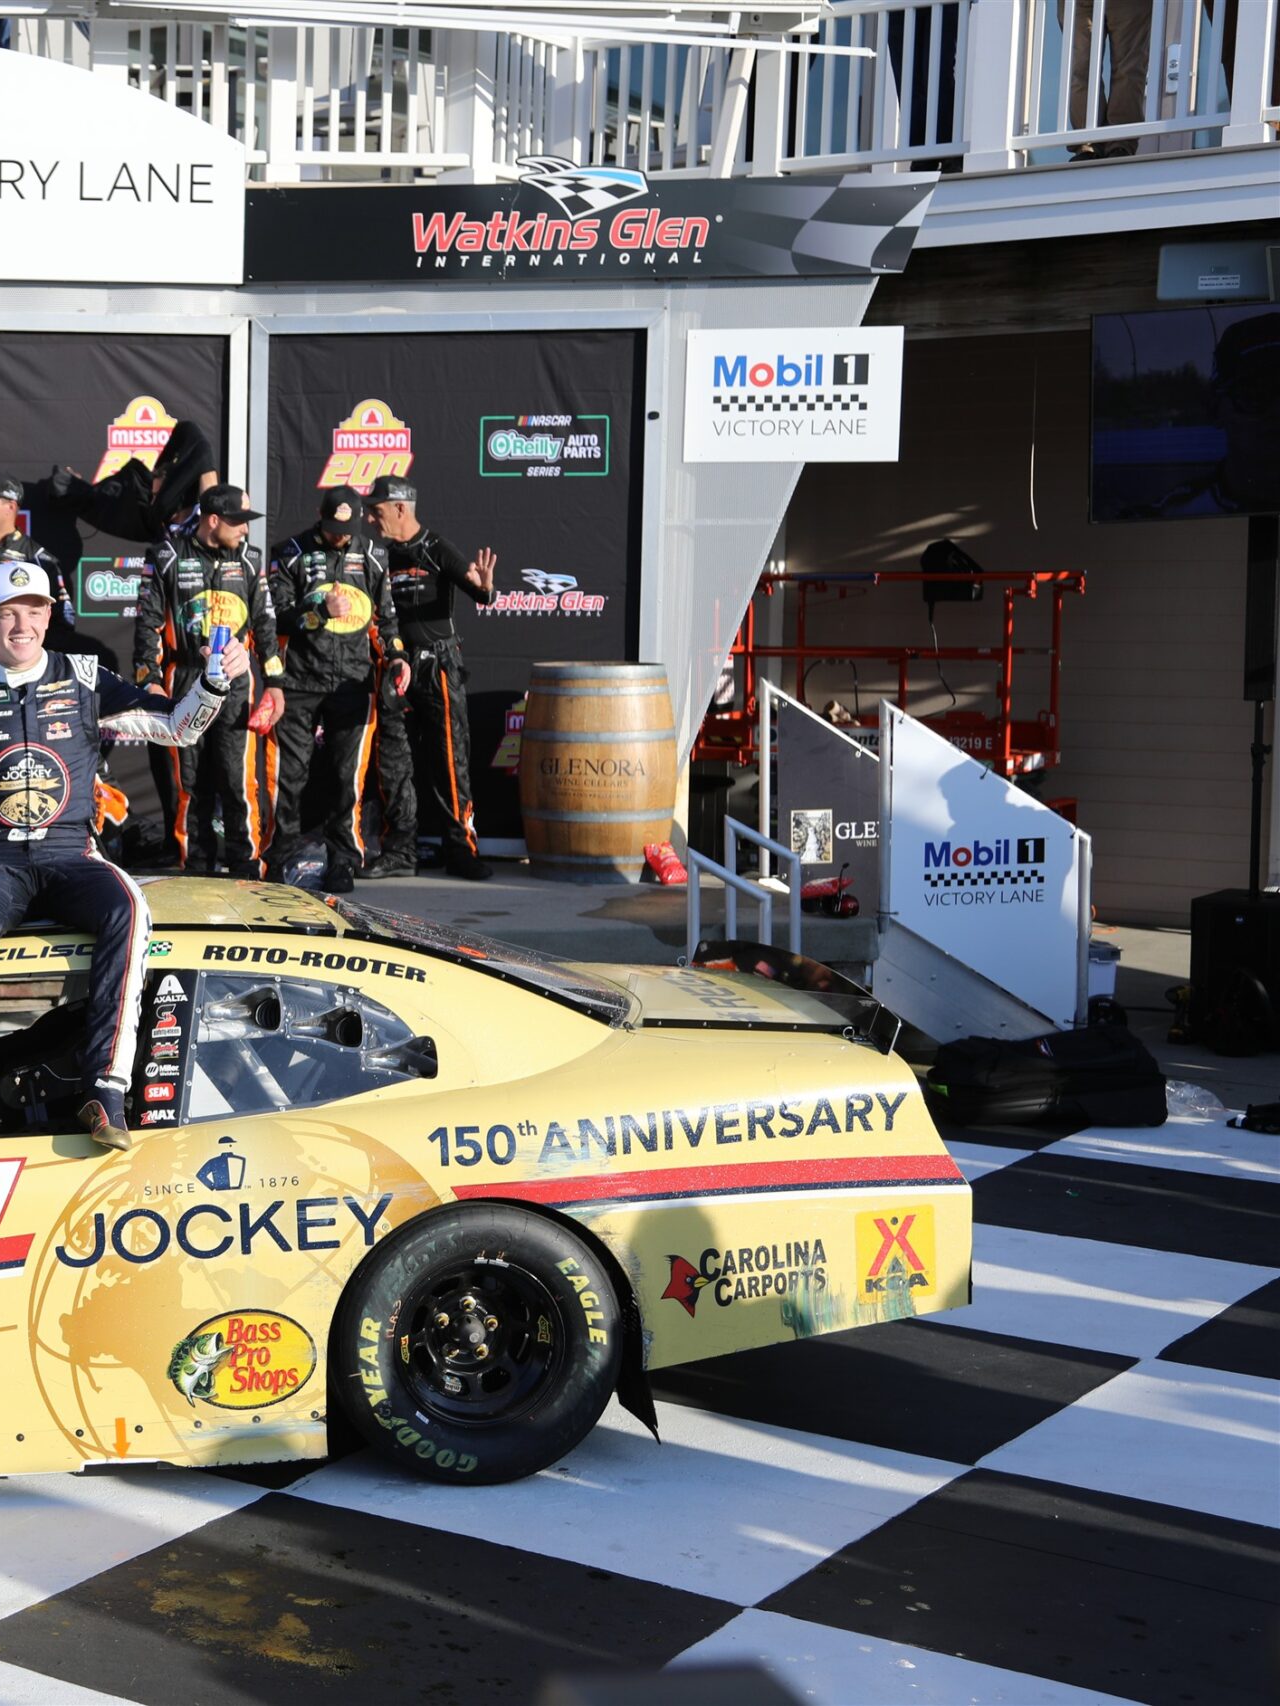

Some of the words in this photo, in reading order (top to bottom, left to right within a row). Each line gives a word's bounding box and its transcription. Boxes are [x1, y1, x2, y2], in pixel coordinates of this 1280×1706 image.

[80, 162, 213, 203] LANE
[412, 211, 600, 252] Watkins
[609, 208, 710, 249] Glen
[416, 252, 702, 268] INTERNATIONAL
[713, 354, 823, 387] Mobil
[531, 415, 572, 426] NASCAR
[712, 419, 804, 436] VICTORY
[811, 418, 867, 435] LANE
[489, 430, 563, 461] O'Reilly
[567, 434, 598, 446] AUTO
[563, 447, 601, 459] PARTS
[526, 466, 561, 477] SERIES
[560, 591, 605, 611] Glen
[540, 757, 645, 777] GLENORA
[835, 821, 880, 840] GLE
[923, 838, 1010, 868] Mobil
[924, 890, 995, 907] VICTORY
[1001, 889, 1045, 904] LANE
[201, 944, 426, 983] ROTO-ROOTER
[153, 993, 188, 1004] AXALTA
[159, 1064, 179, 1072] Miller
[148, 1086, 169, 1098] SEM
[538, 1091, 908, 1164] ANNIVERSARY
[144, 1182, 196, 1197] SINCE
[259, 1176, 300, 1188] 1876
[55, 1193, 393, 1268] JOCKEY
[699, 1239, 827, 1282] CAROLINA
[714, 1267, 827, 1307] CARPORTS
[555, 1256, 608, 1346] EAGLE
[225, 1318, 281, 1345] Bass
[228, 1343, 271, 1367] Pro
[229, 1366, 300, 1396] Shops
